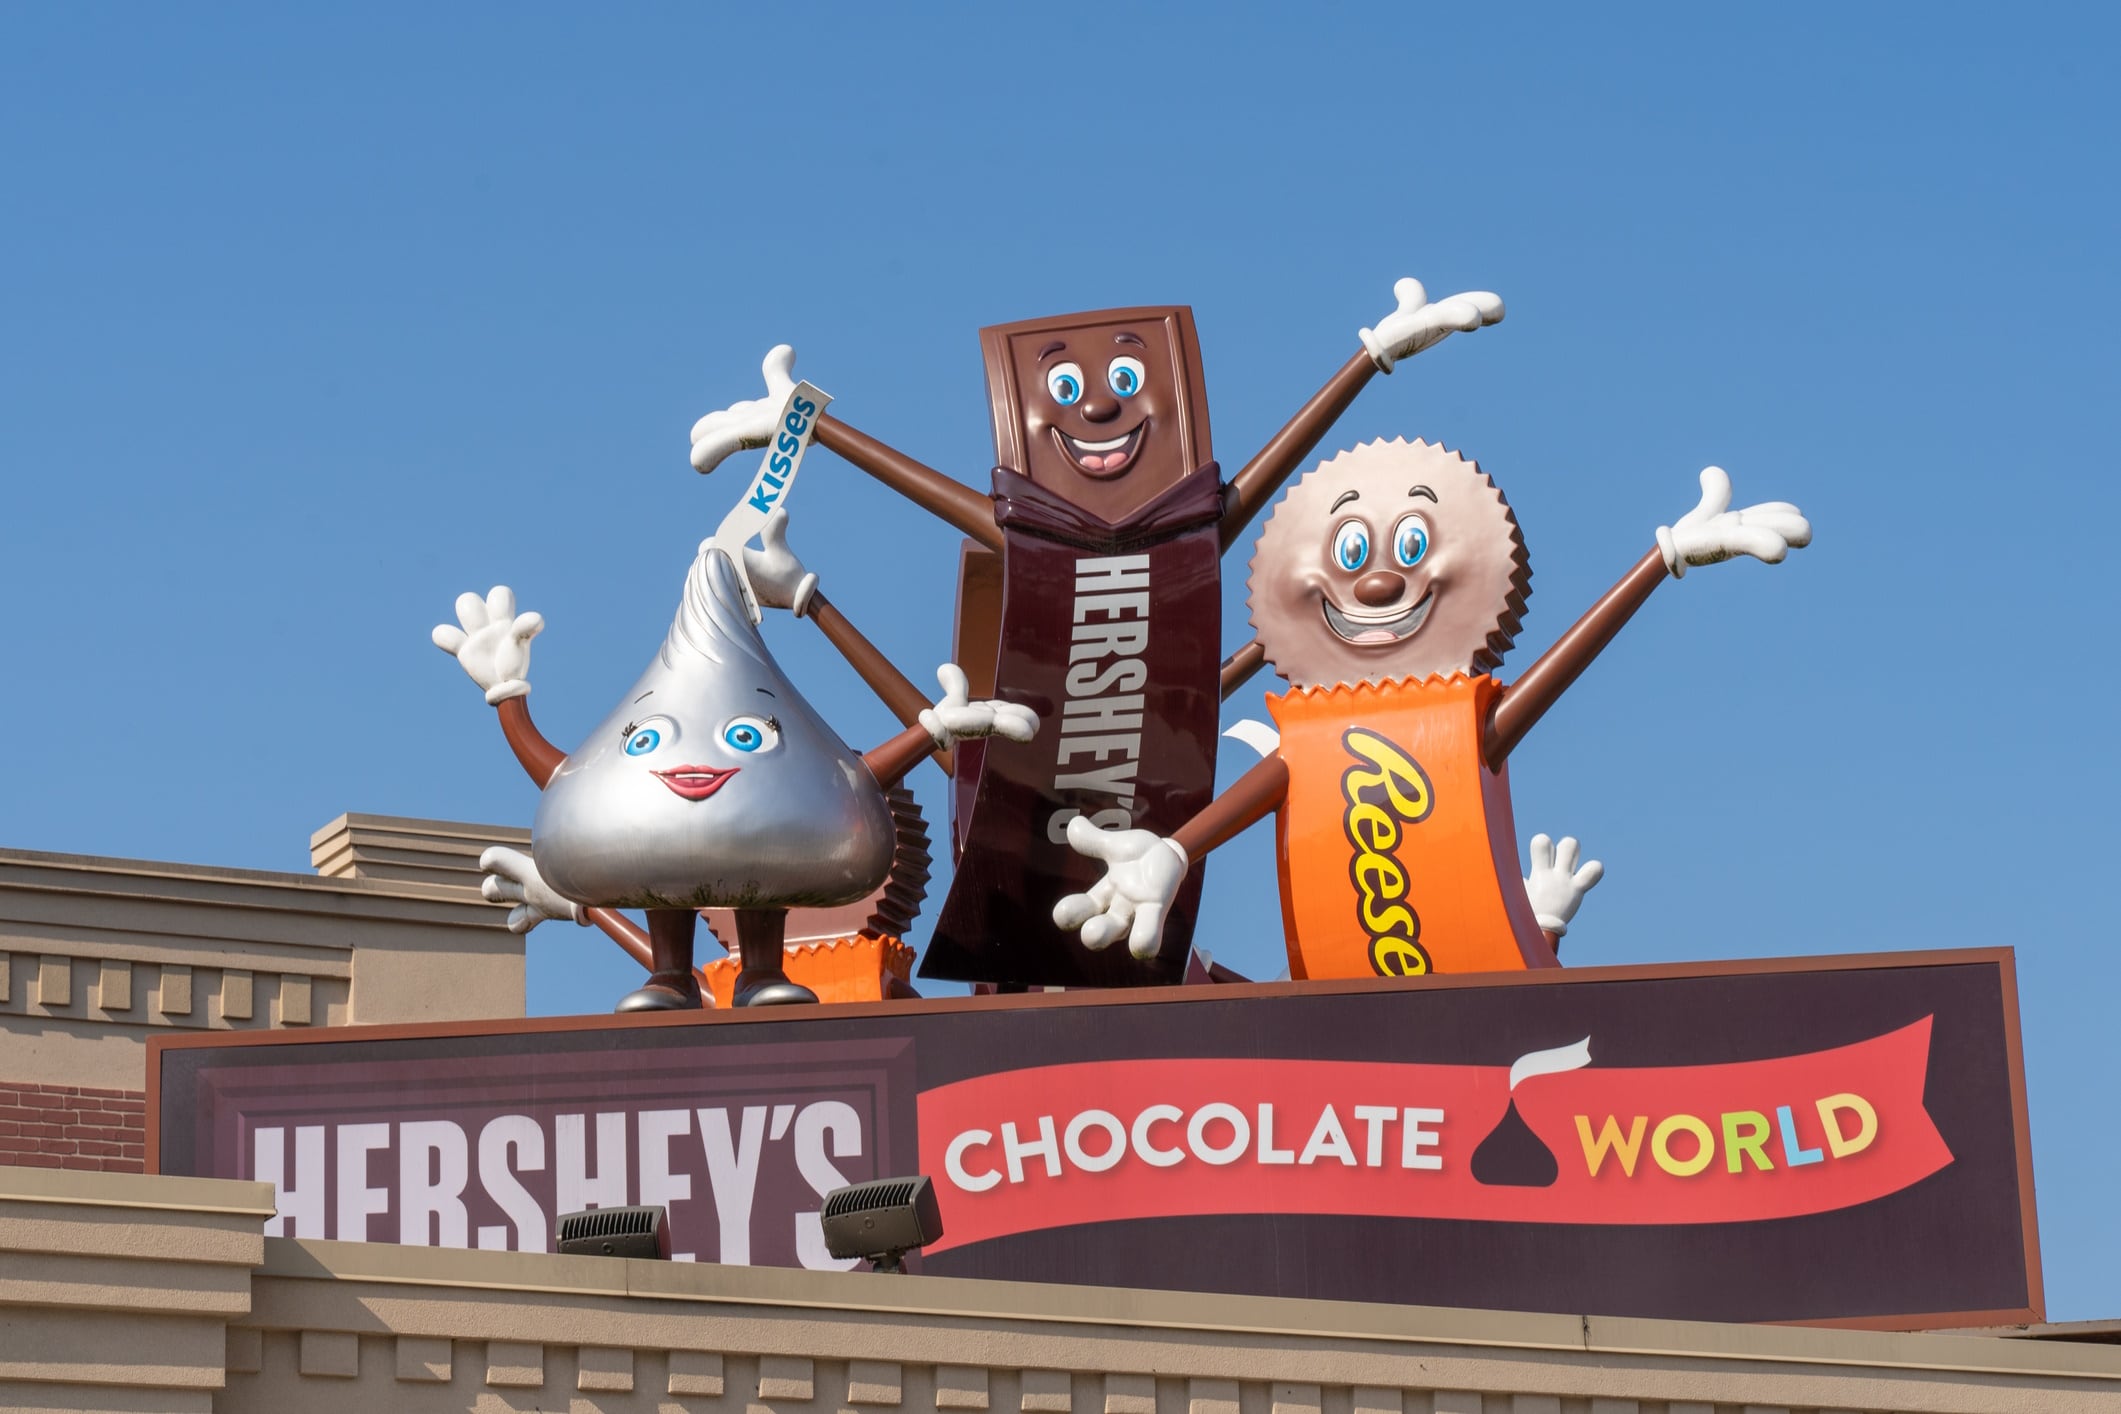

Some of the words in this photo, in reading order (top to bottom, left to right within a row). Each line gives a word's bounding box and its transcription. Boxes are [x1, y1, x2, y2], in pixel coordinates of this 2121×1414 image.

[254, 1101, 863, 1273] HERSHEY'S
[944, 1102, 1445, 1193] CHOCOLATE
[1574, 1093, 1879, 1178] WORLD
